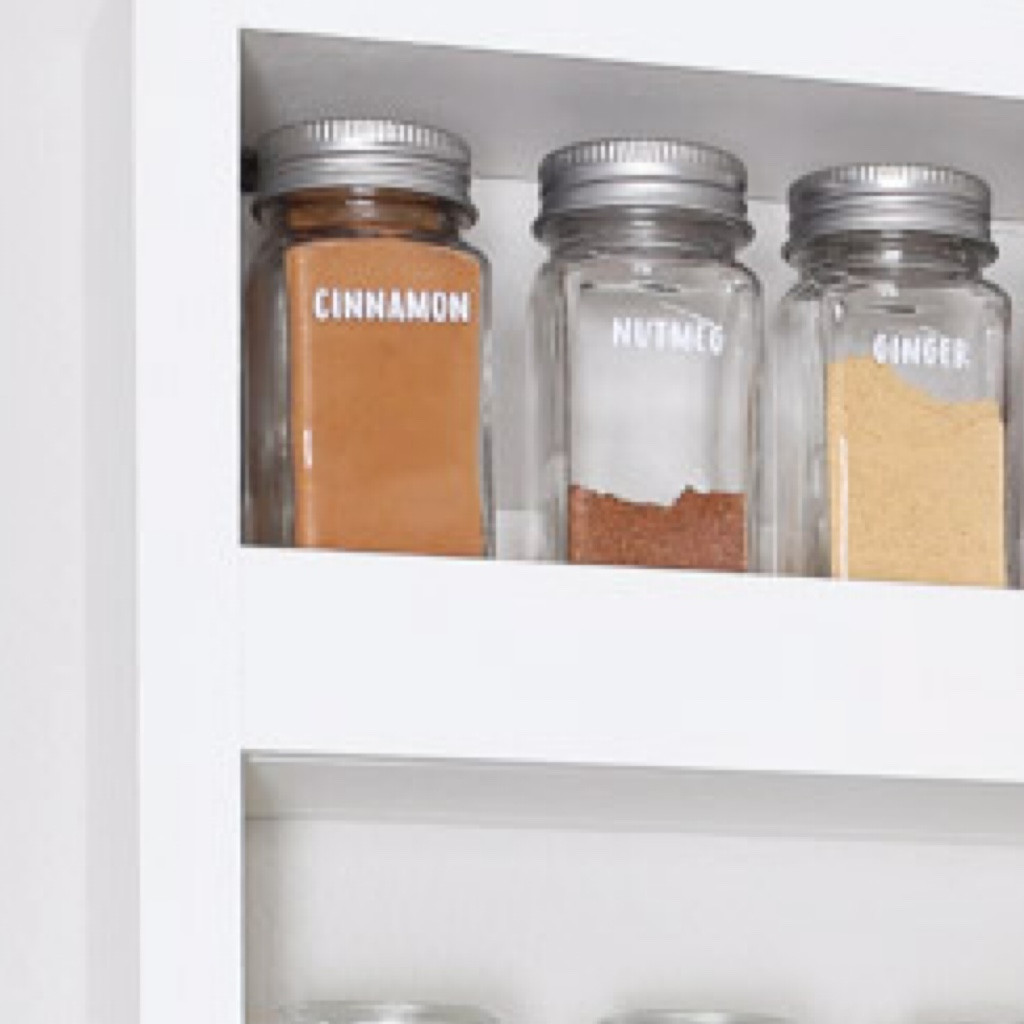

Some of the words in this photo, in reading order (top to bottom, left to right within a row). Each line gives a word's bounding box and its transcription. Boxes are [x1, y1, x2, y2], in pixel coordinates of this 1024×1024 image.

[314, 288, 470, 323] CINNAMON
[613, 317, 724, 356] NUTMEG
[872, 334, 970, 369] GINGER
